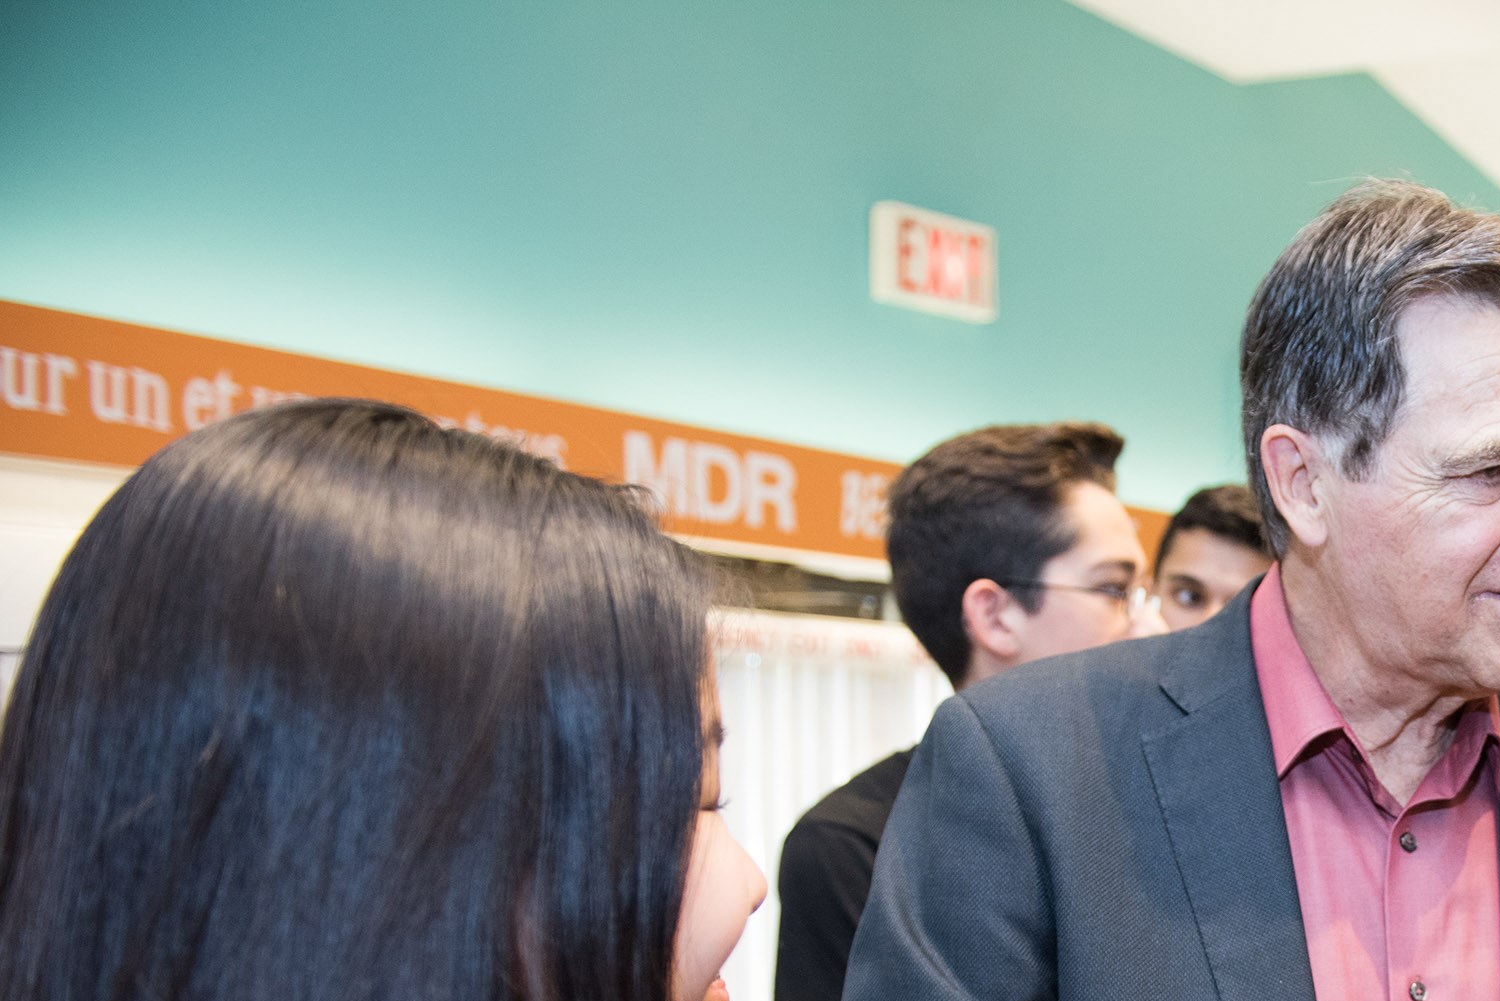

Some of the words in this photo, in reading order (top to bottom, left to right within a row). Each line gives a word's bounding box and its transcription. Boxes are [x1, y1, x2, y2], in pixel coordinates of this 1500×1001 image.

[896, 217, 992, 309] EXIT
[87, 359, 172, 433] un
[182, 370, 240, 431] et
[622, 430, 796, 533] MDR
